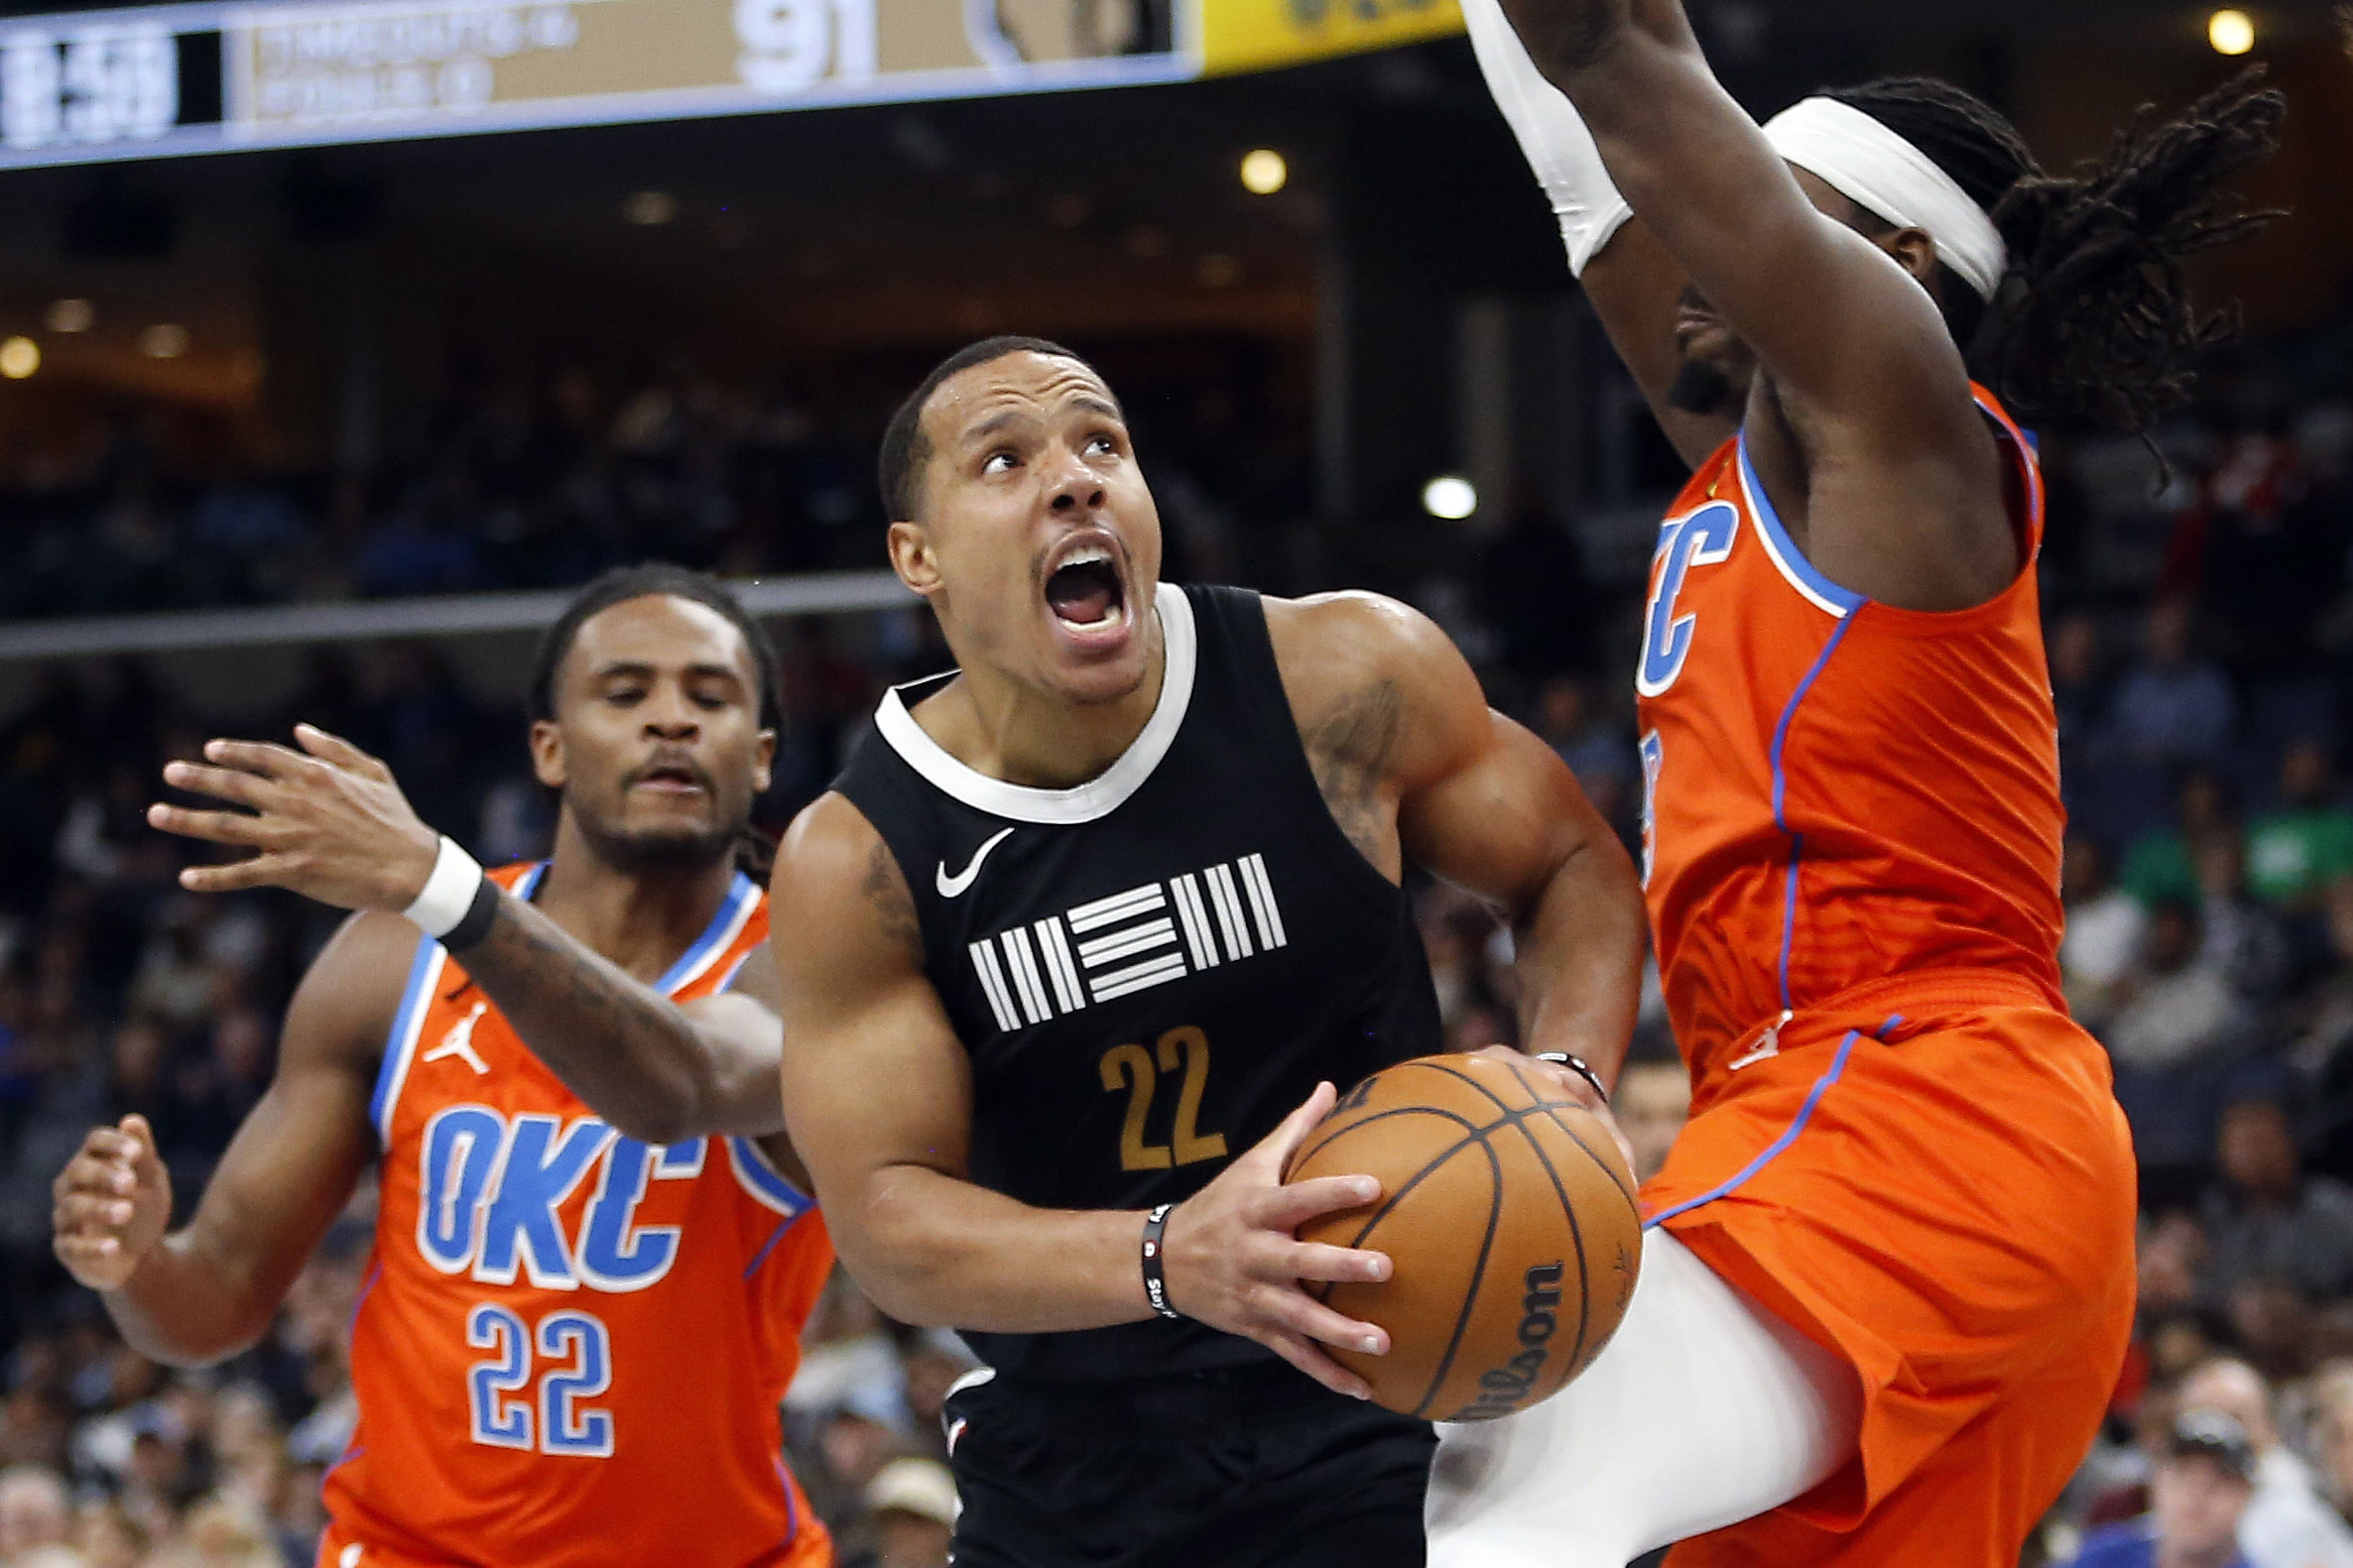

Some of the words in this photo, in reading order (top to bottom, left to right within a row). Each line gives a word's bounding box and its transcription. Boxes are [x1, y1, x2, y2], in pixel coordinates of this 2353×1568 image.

[734, 0, 878, 94] 91
[1099, 1025, 1228, 1171] 22
[417, 1104, 708, 1293] OKC
[466, 1302, 614, 1458] 22
